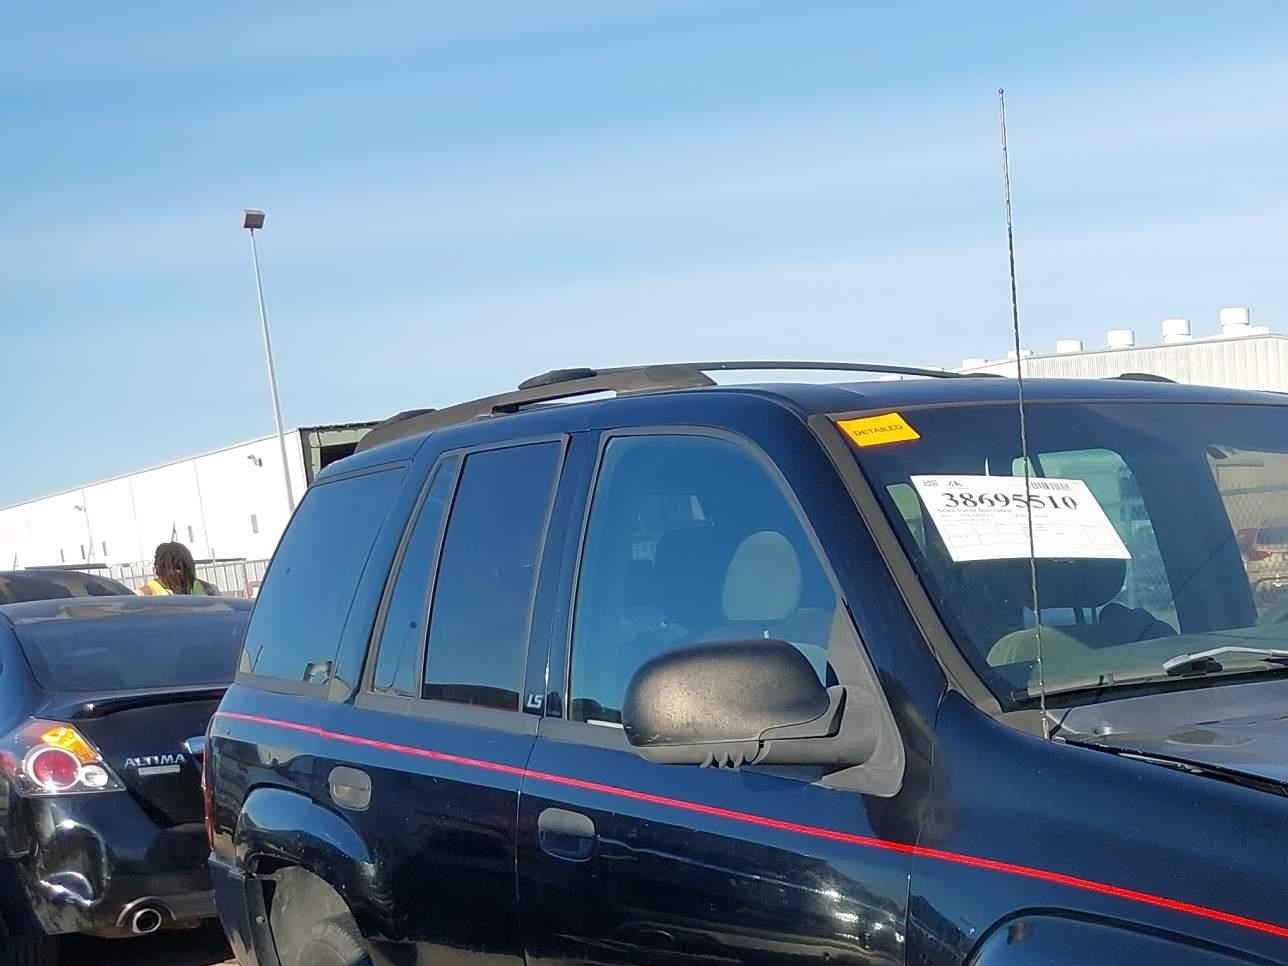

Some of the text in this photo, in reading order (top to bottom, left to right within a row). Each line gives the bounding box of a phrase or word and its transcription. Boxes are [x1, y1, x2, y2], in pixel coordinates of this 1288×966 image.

[853, 424, 904, 437] DETAILED
[941, 492, 1079, 511] 38695510
[527, 693, 544, 709] LS
[124, 753, 185, 768] ALTIMA
